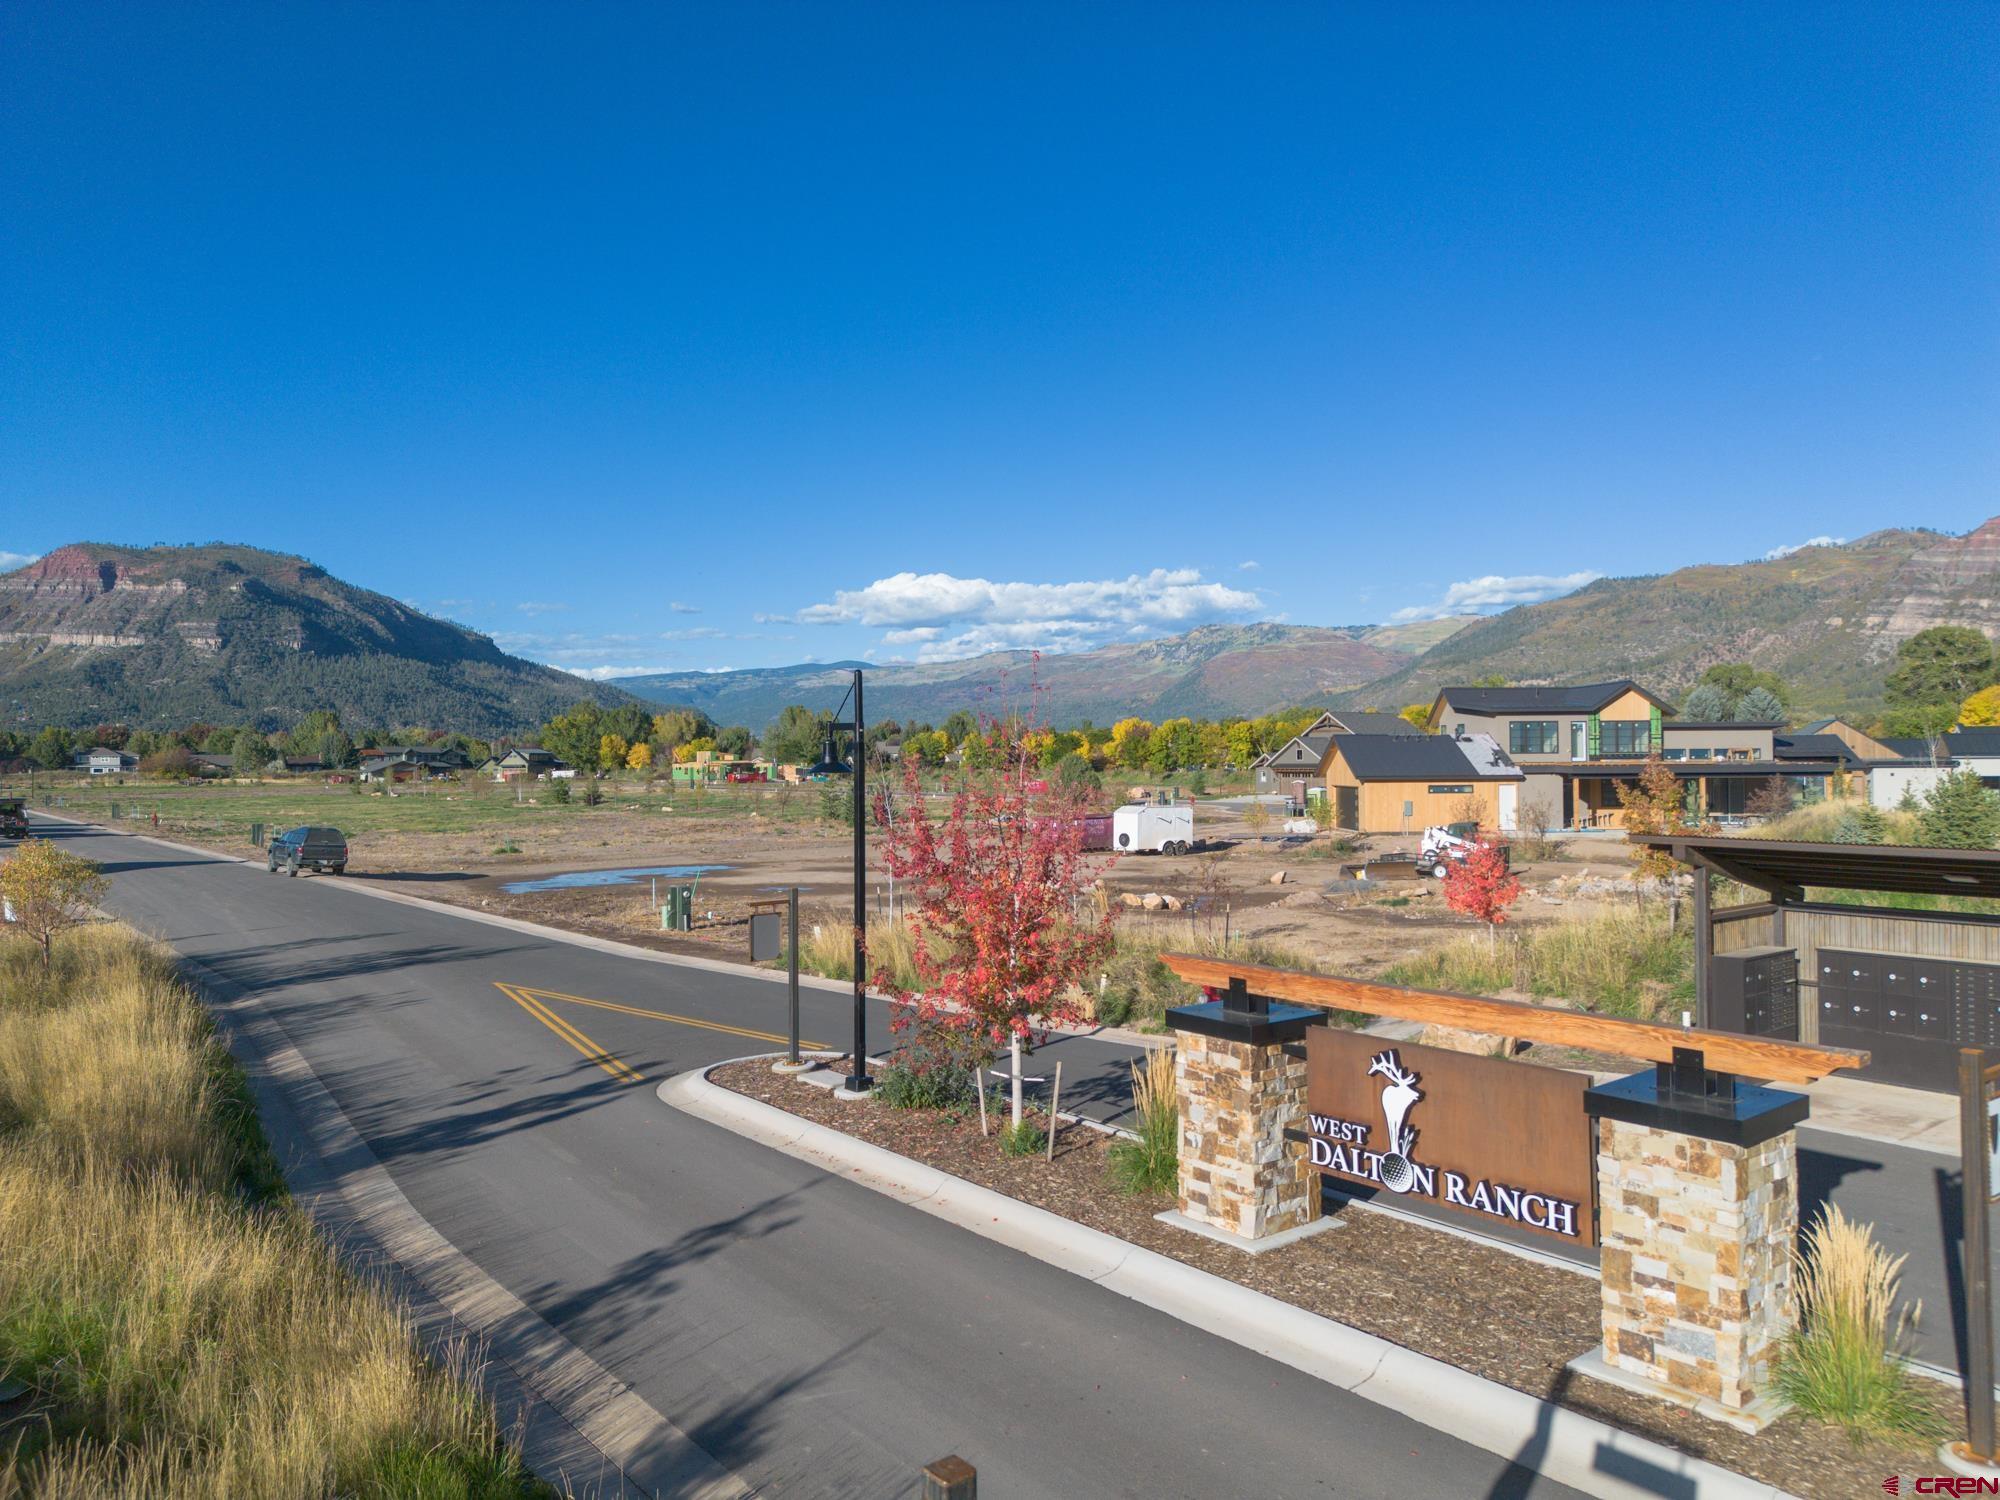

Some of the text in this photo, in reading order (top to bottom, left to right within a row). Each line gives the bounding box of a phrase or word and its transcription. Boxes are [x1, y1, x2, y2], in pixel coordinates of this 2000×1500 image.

[1308, 1114, 1367, 1145] WEST
[1310, 1137, 1576, 1236] DALTON RANCH
